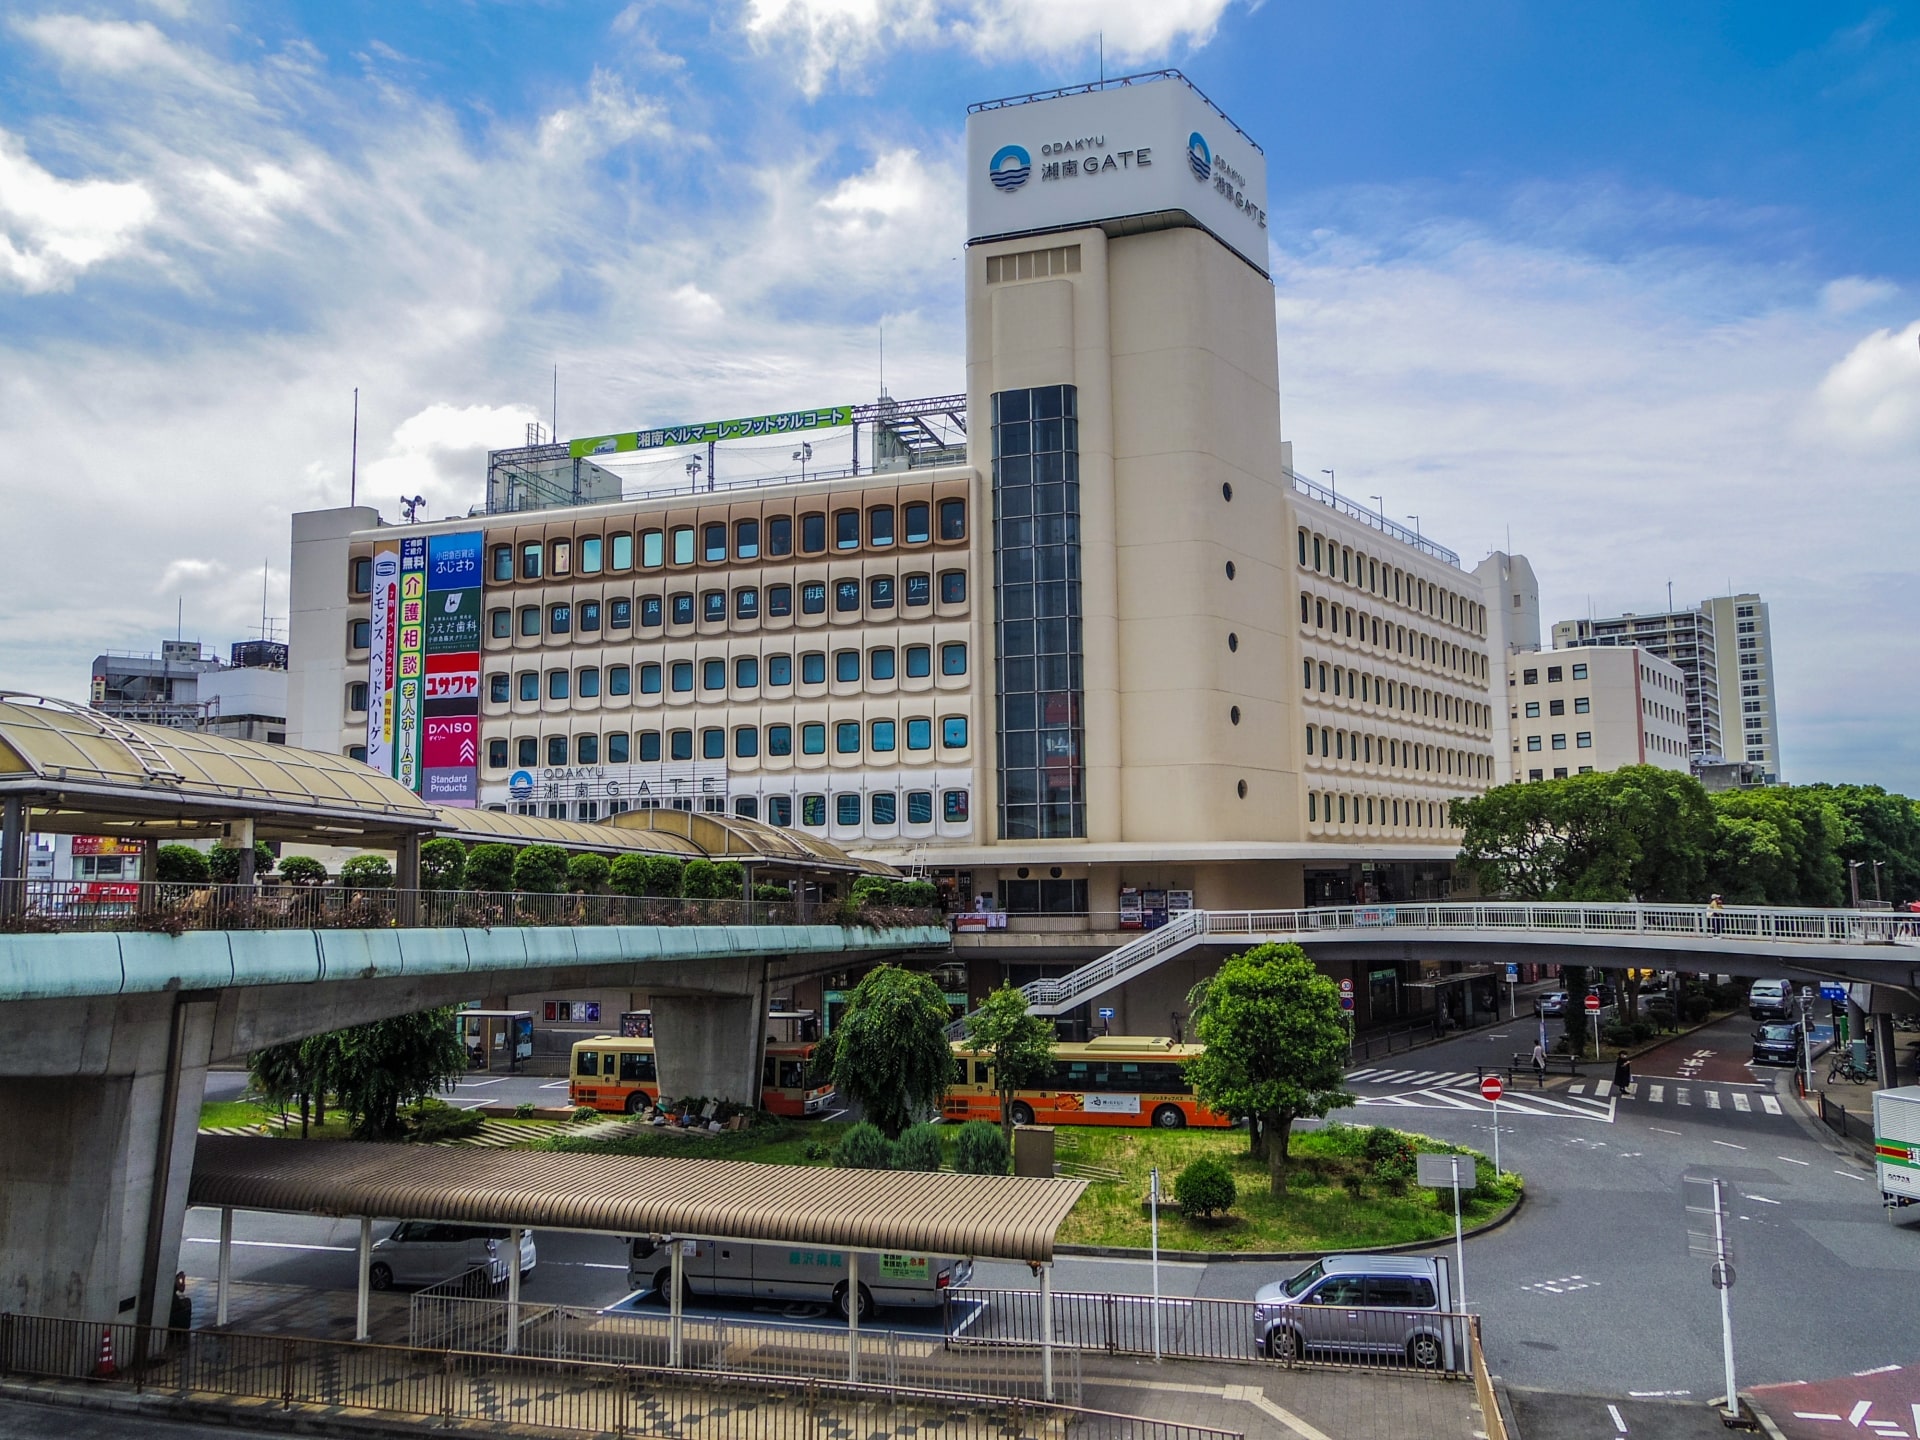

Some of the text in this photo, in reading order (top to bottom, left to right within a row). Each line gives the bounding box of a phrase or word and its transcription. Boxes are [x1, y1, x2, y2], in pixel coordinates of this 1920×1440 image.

[1041, 136, 1105, 156] ODAKYU
[1214, 154, 1246, 187] ODAKYU
[637, 409, 843, 448] 湘南ベルマーレ・フットサルコート
[402, 555, 424, 570] 無料
[435, 549, 475, 561] 小田急百貨店
[435, 560, 475, 574] ふじさわ
[554, 607, 569, 621] 6F
[402, 576, 420, 675] 介護相談
[429, 619, 477, 635] うえだ歯科
[385, 611, 394, 681] イベントスクエア
[370, 583, 385, 755] シモンズ ベッドバーゲン
[400, 682, 417, 786] 老人ホーム紹介
[428, 722, 473, 735] DAISO
[430, 775, 468, 784] Standard
[543, 766, 604, 780] ODAKYU
[430, 783, 467, 792] Products
[789, 1251, 842, 1267] 藤沢病院
